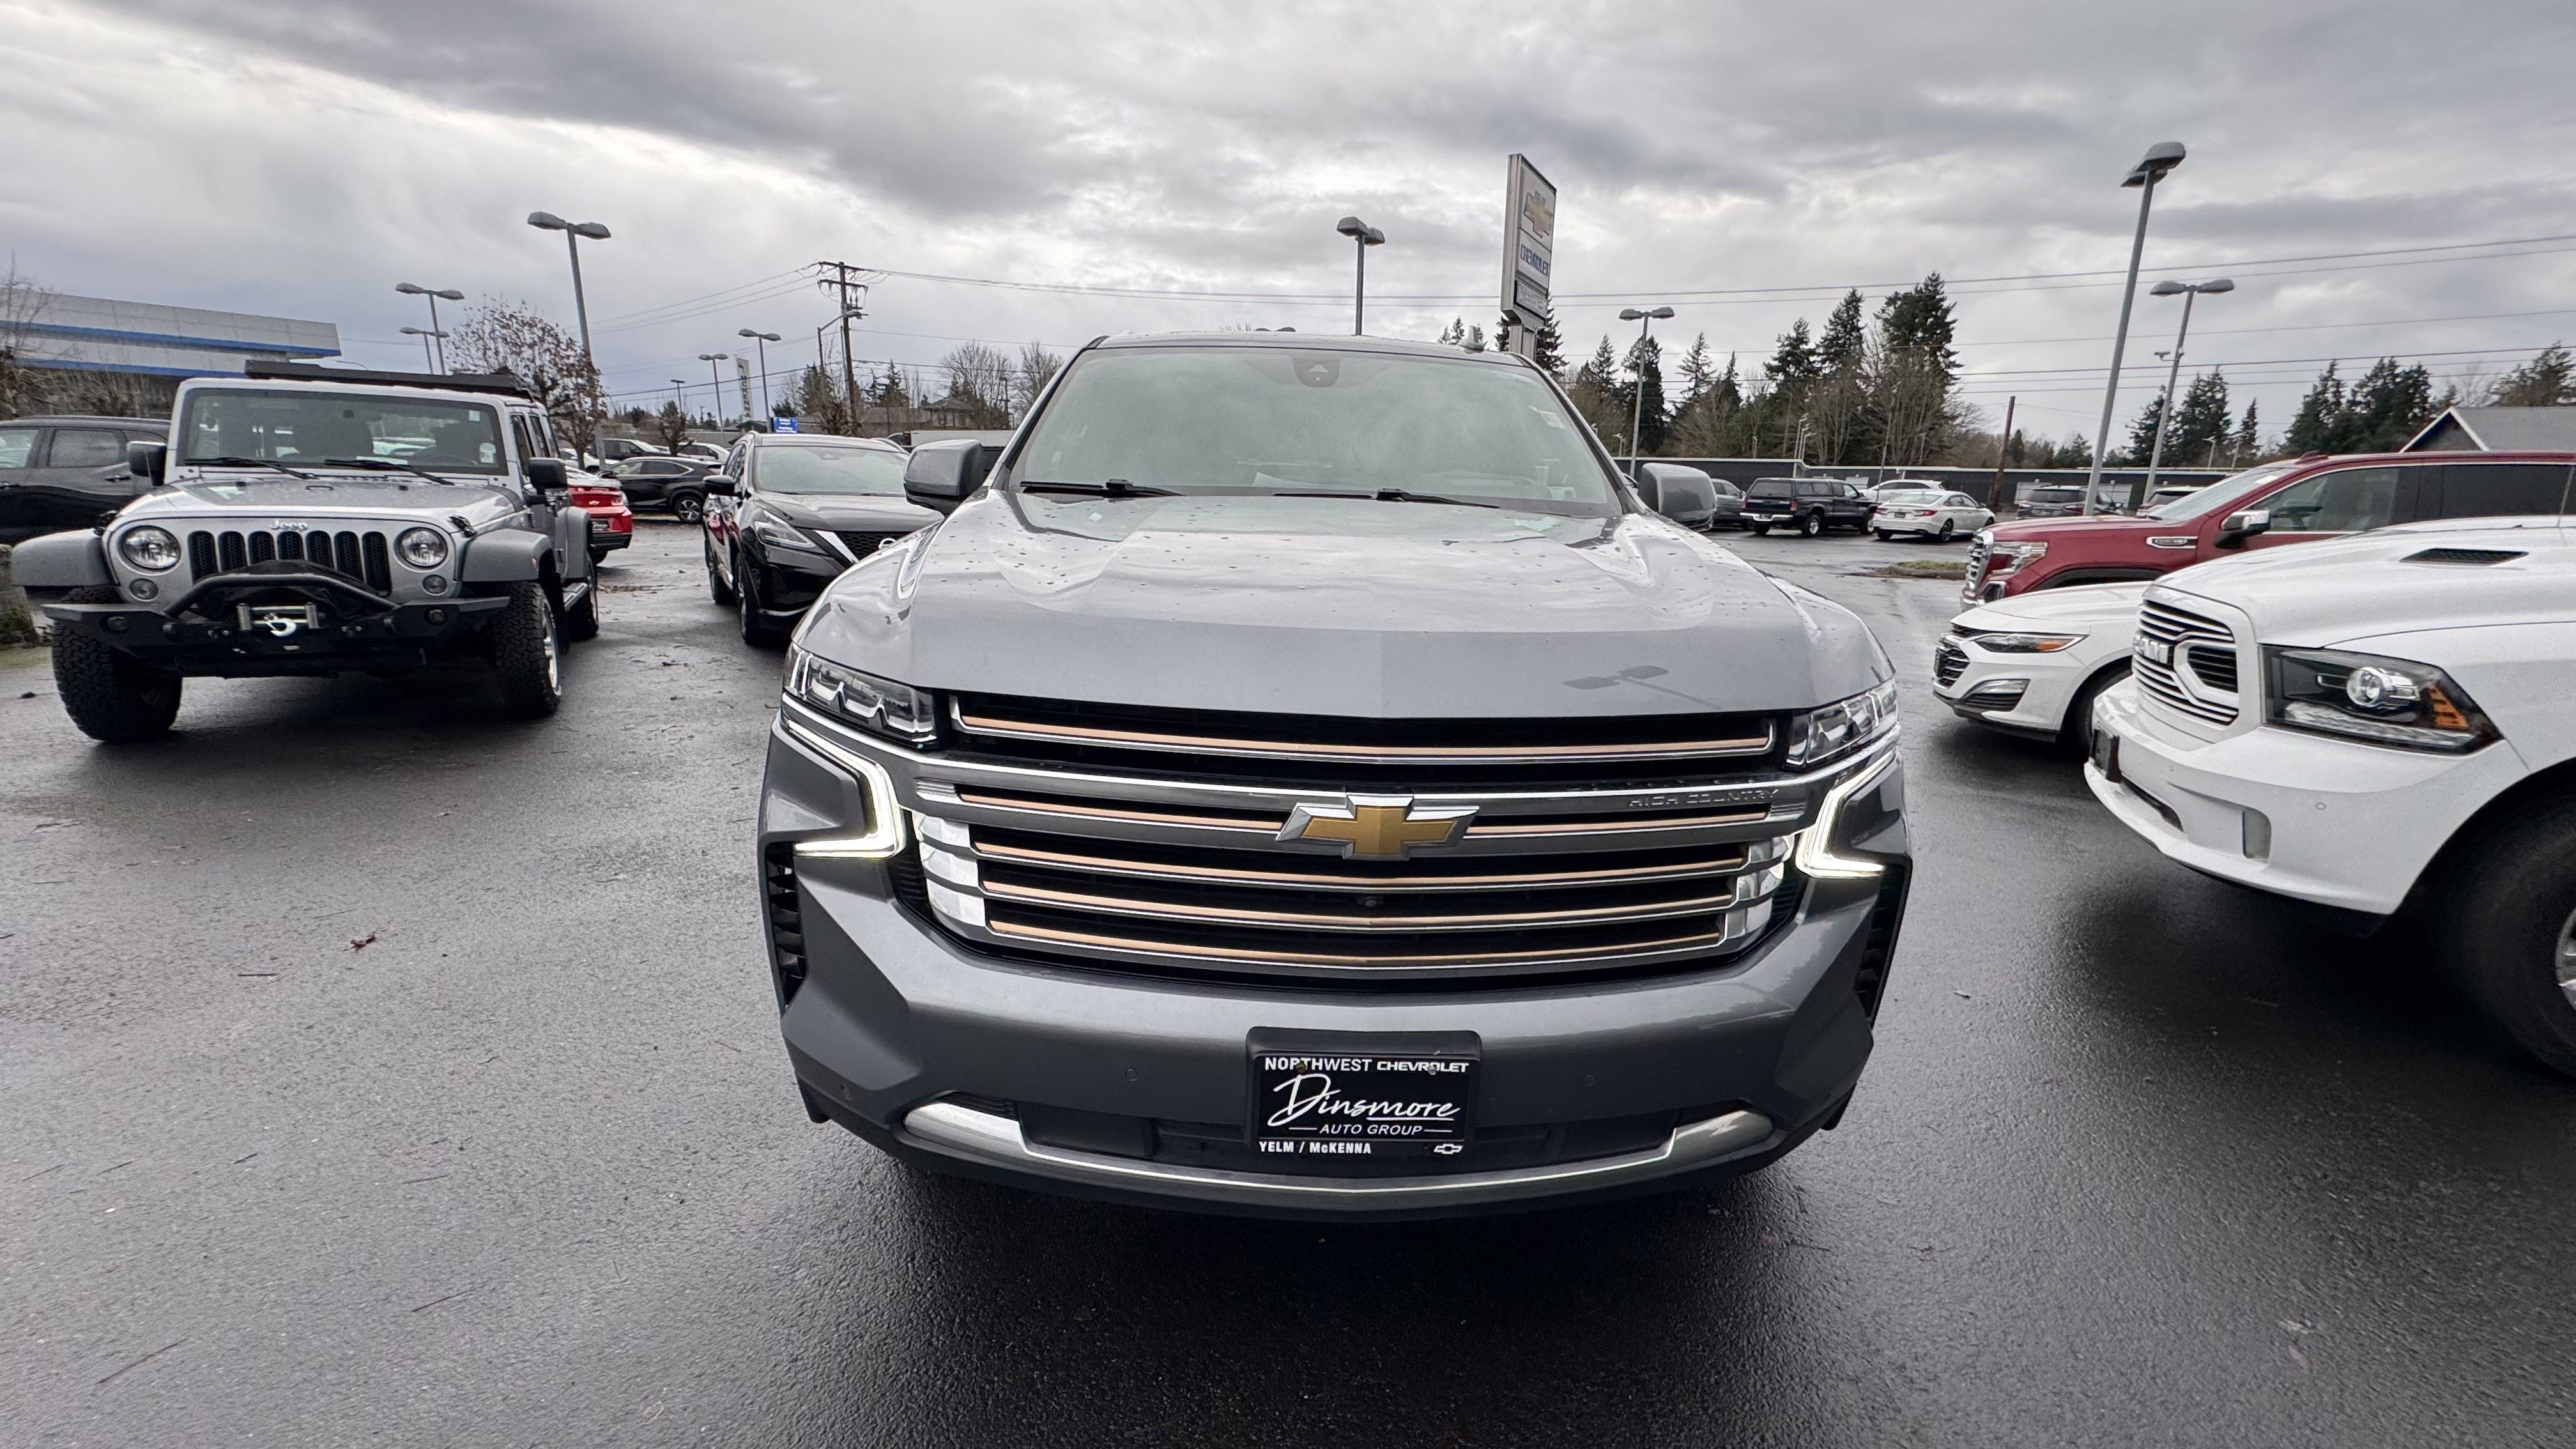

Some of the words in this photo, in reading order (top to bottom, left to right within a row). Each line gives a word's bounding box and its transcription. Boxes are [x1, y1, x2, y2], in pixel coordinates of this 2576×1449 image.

[268, 520, 308, 532] Jeep
[1264, 1057, 1373, 1072] NORTHWEST
[1377, 1061, 1469, 1073] CHEVROLET
[1267, 1073, 1461, 1127] Dinsmore
[1319, 1124, 1362, 1135] AUTO
[1367, 1125, 1423, 1136] GROUP
[1259, 1141, 1294, 1153] YELM
[1309, 1142, 1372, 1154] McKENNA
